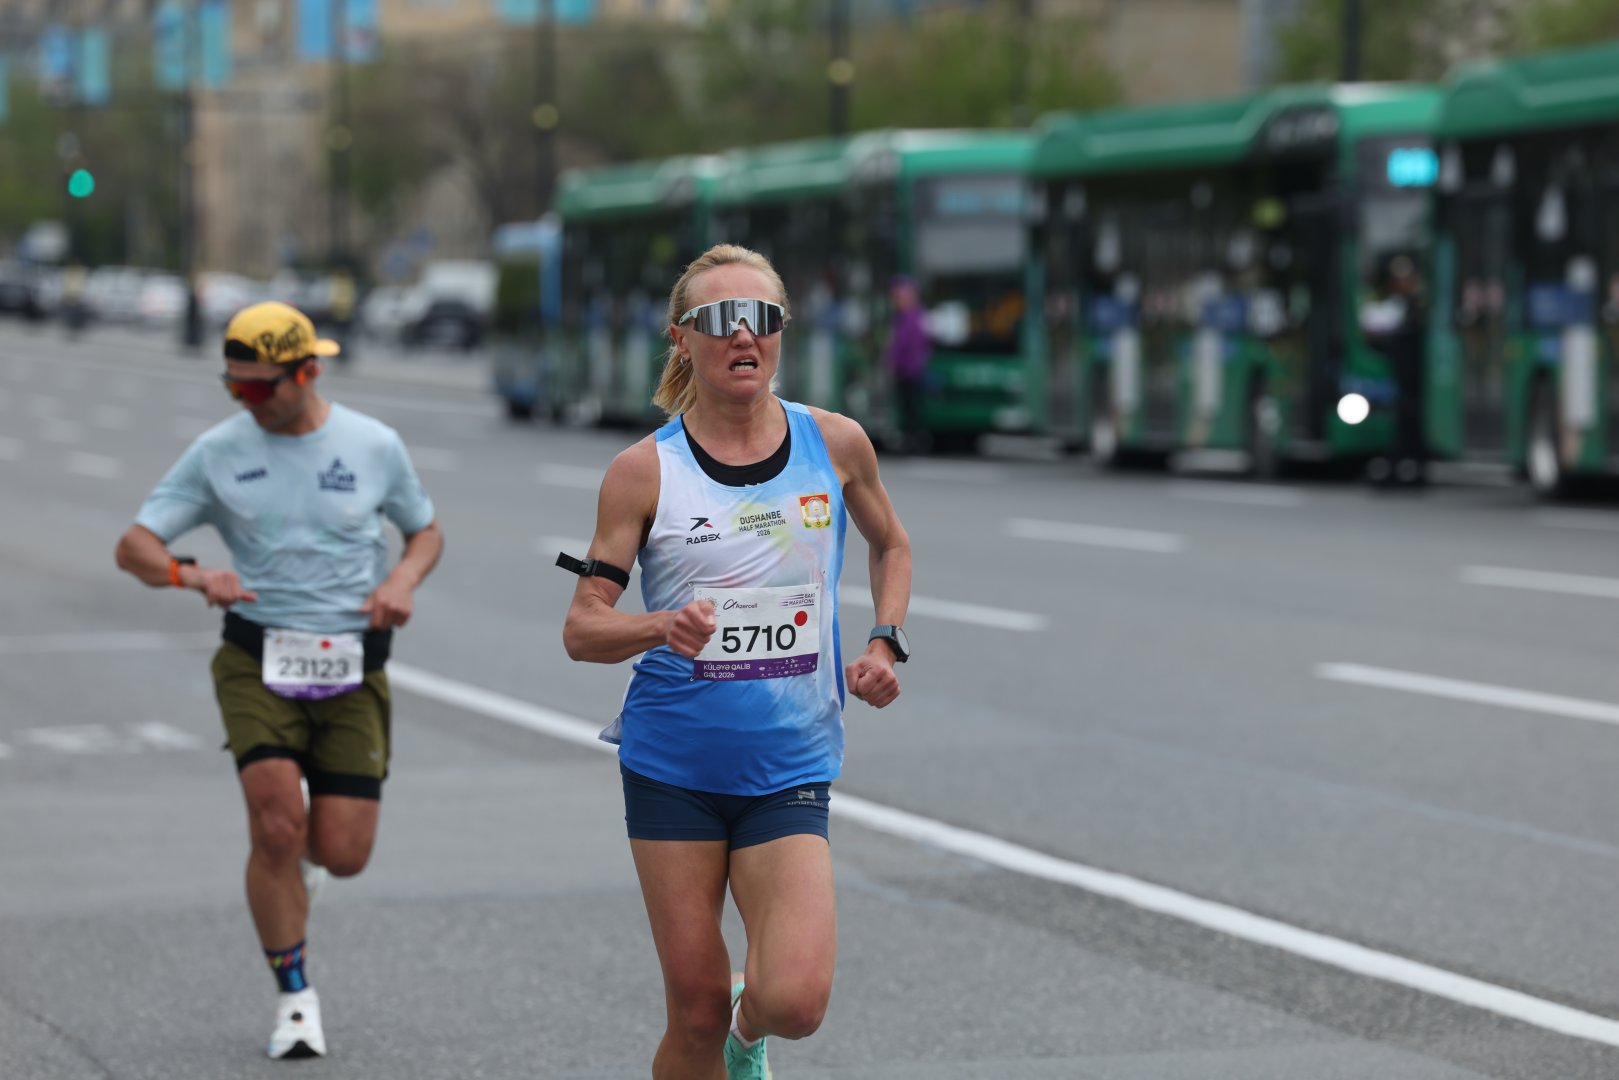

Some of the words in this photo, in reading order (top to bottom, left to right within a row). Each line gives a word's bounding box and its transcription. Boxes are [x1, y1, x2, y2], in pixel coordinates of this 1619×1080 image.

[739, 510, 782, 525] DUSHANBE
[738, 524, 753, 532] HALF
[754, 519, 786, 530] MARATHON
[685, 532, 722, 546] RABEX
[756, 529, 771, 537] 2026
[721, 623, 797, 654] 5710
[277, 656, 350, 678] 23123
